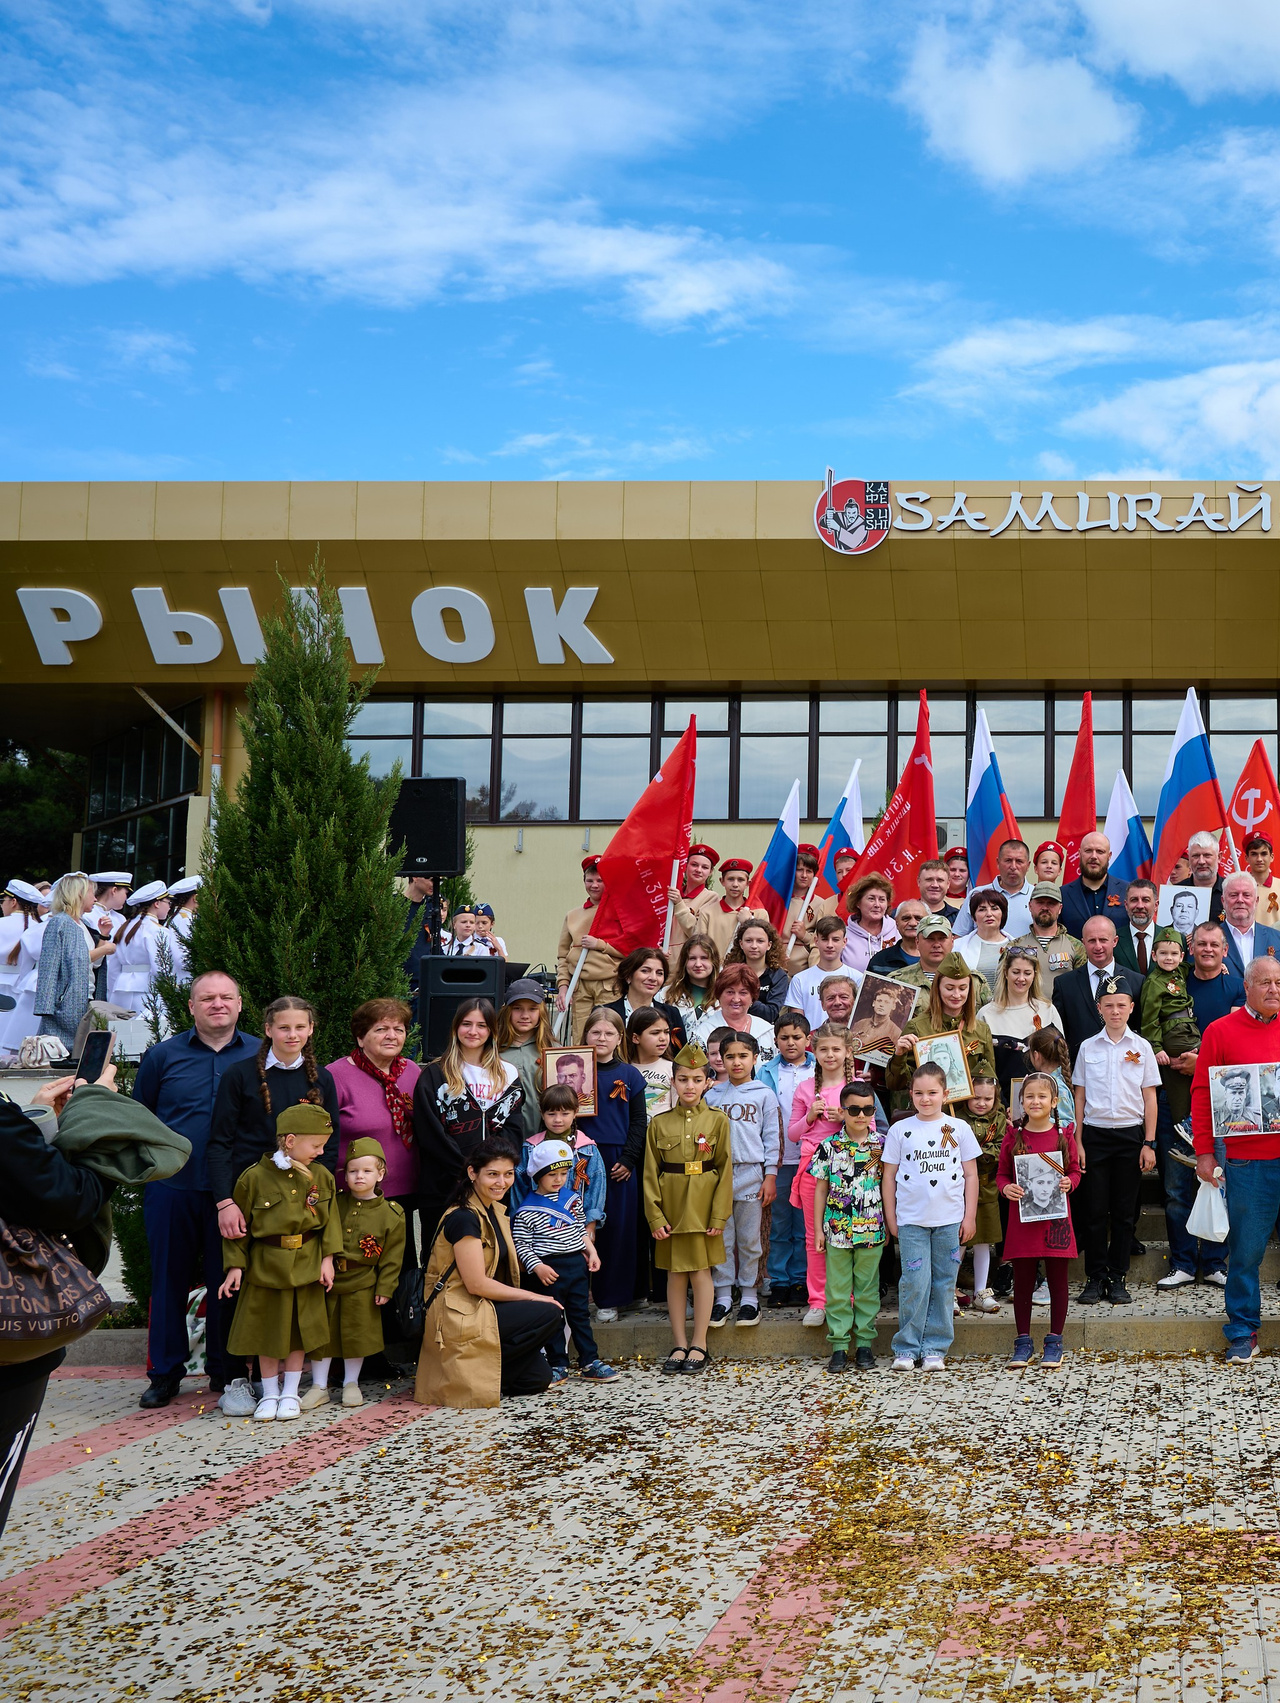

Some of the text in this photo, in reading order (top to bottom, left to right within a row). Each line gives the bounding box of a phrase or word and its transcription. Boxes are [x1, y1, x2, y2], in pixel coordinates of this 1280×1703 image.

[641, 1069, 667, 1083] Way
[913, 1149, 951, 1161] Мамина
[919, 1160, 946, 1174] Доча
